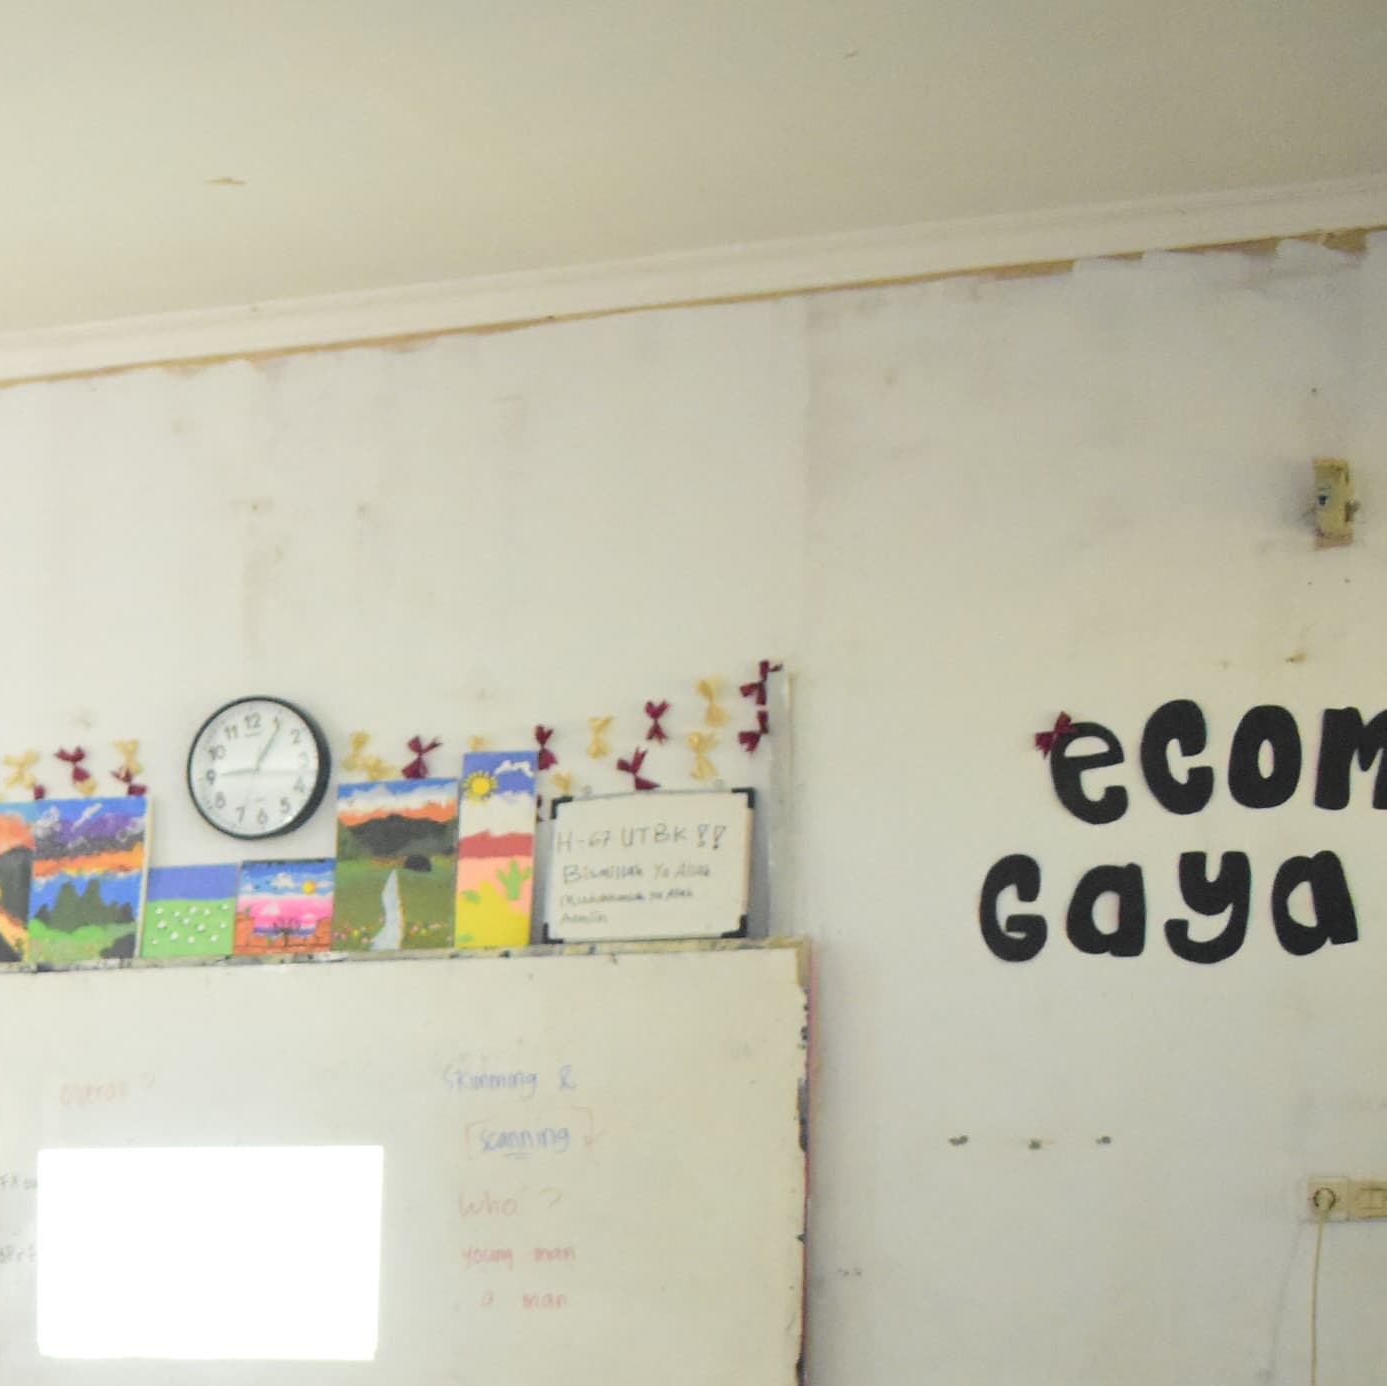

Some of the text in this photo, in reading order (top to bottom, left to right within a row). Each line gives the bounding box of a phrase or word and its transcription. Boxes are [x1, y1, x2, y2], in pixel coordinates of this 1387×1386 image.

[244, 713, 261, 729] 12
[225, 725, 238, 741] 11
[291, 729, 301, 744] 2
[209, 745, 226, 760] 10
[206, 769, 216, 784] 9
[293, 778, 305, 793] 4
[215, 793, 226, 809] 8
[280, 797, 291, 814] 5
[236, 806, 246, 822] 7
[257, 809, 268, 825] 6
[620, 823, 688, 848] UTBK
[978, 849, 1359, 965] Gaya
